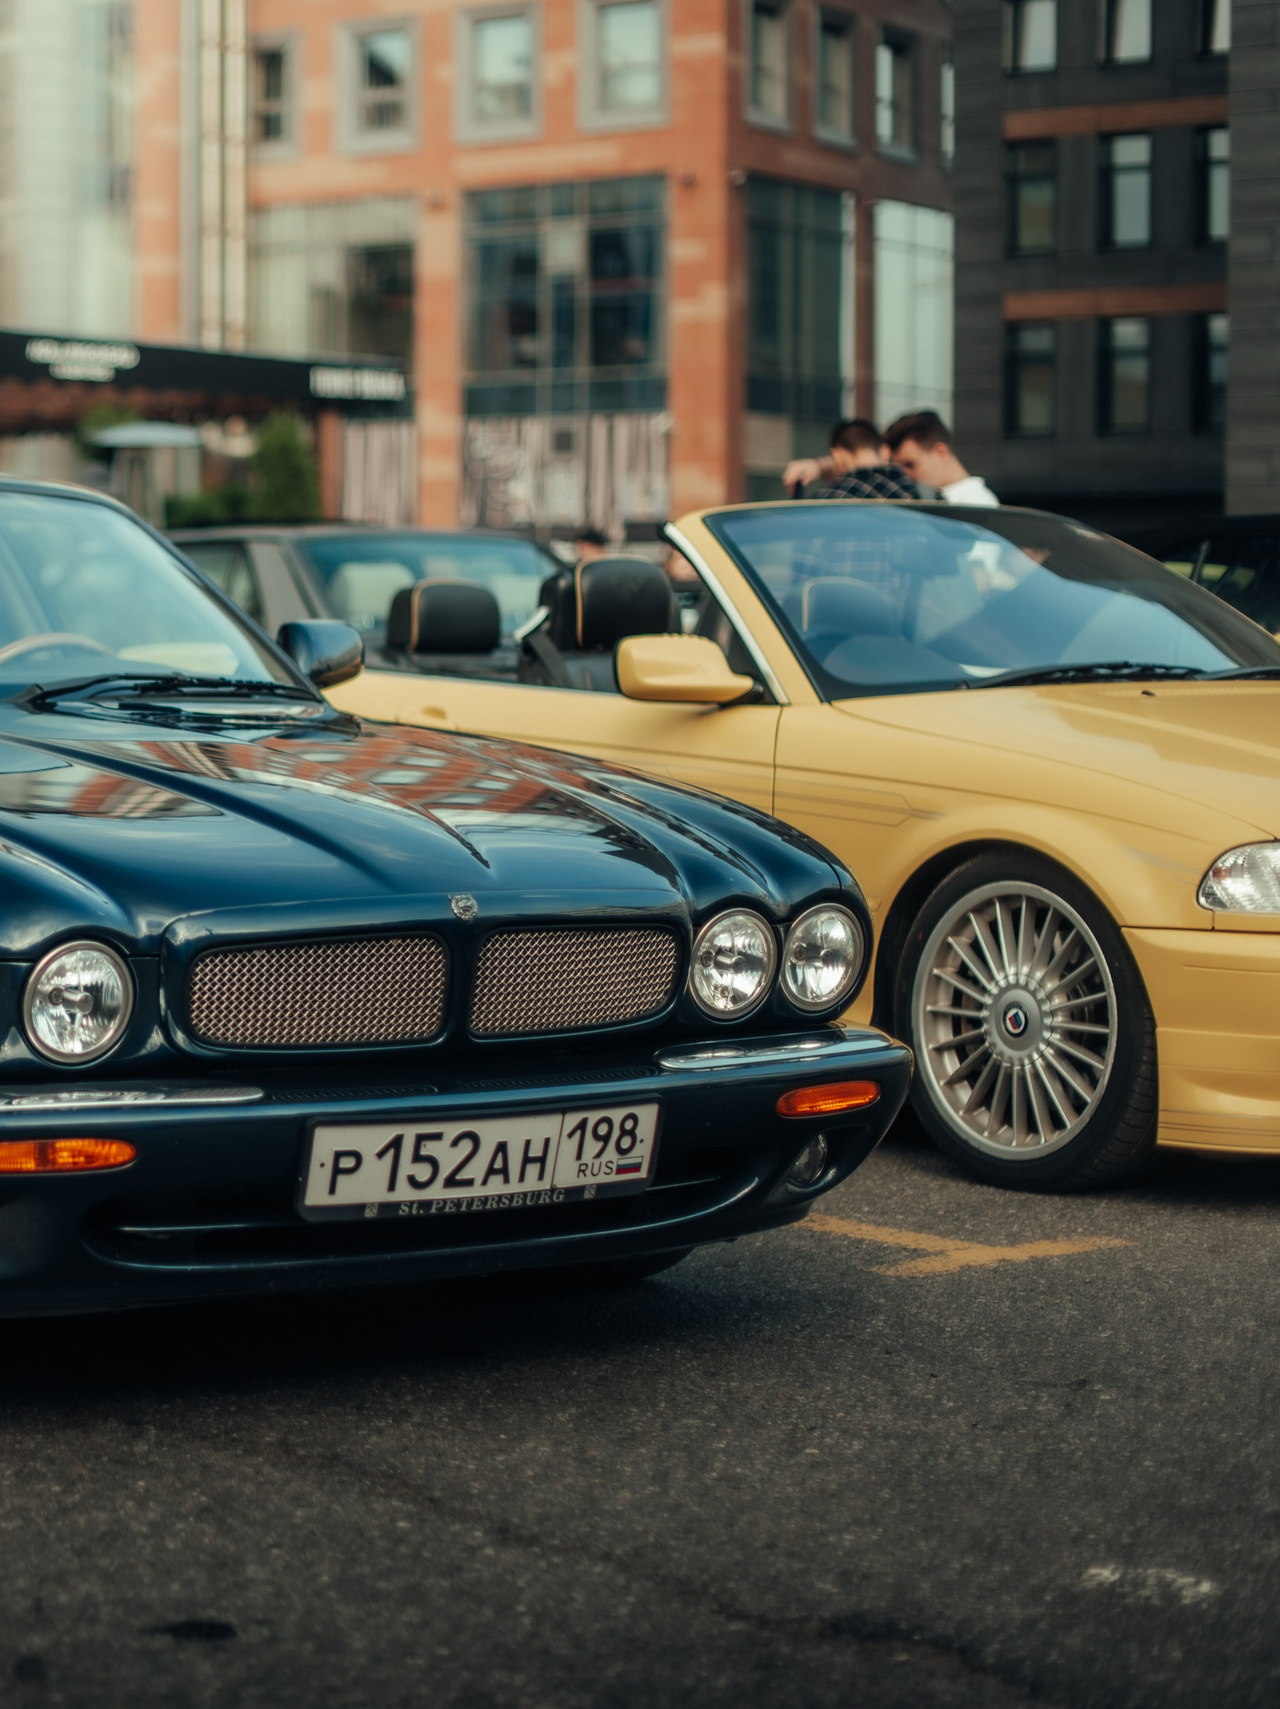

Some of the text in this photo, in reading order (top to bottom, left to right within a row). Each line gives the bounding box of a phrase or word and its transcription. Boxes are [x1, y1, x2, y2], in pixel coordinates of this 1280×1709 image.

[566, 1111, 639, 1161] 198
[576, 1160, 614, 1178] RUS
[398, 1188, 565, 1215] St. PETERSBURG
